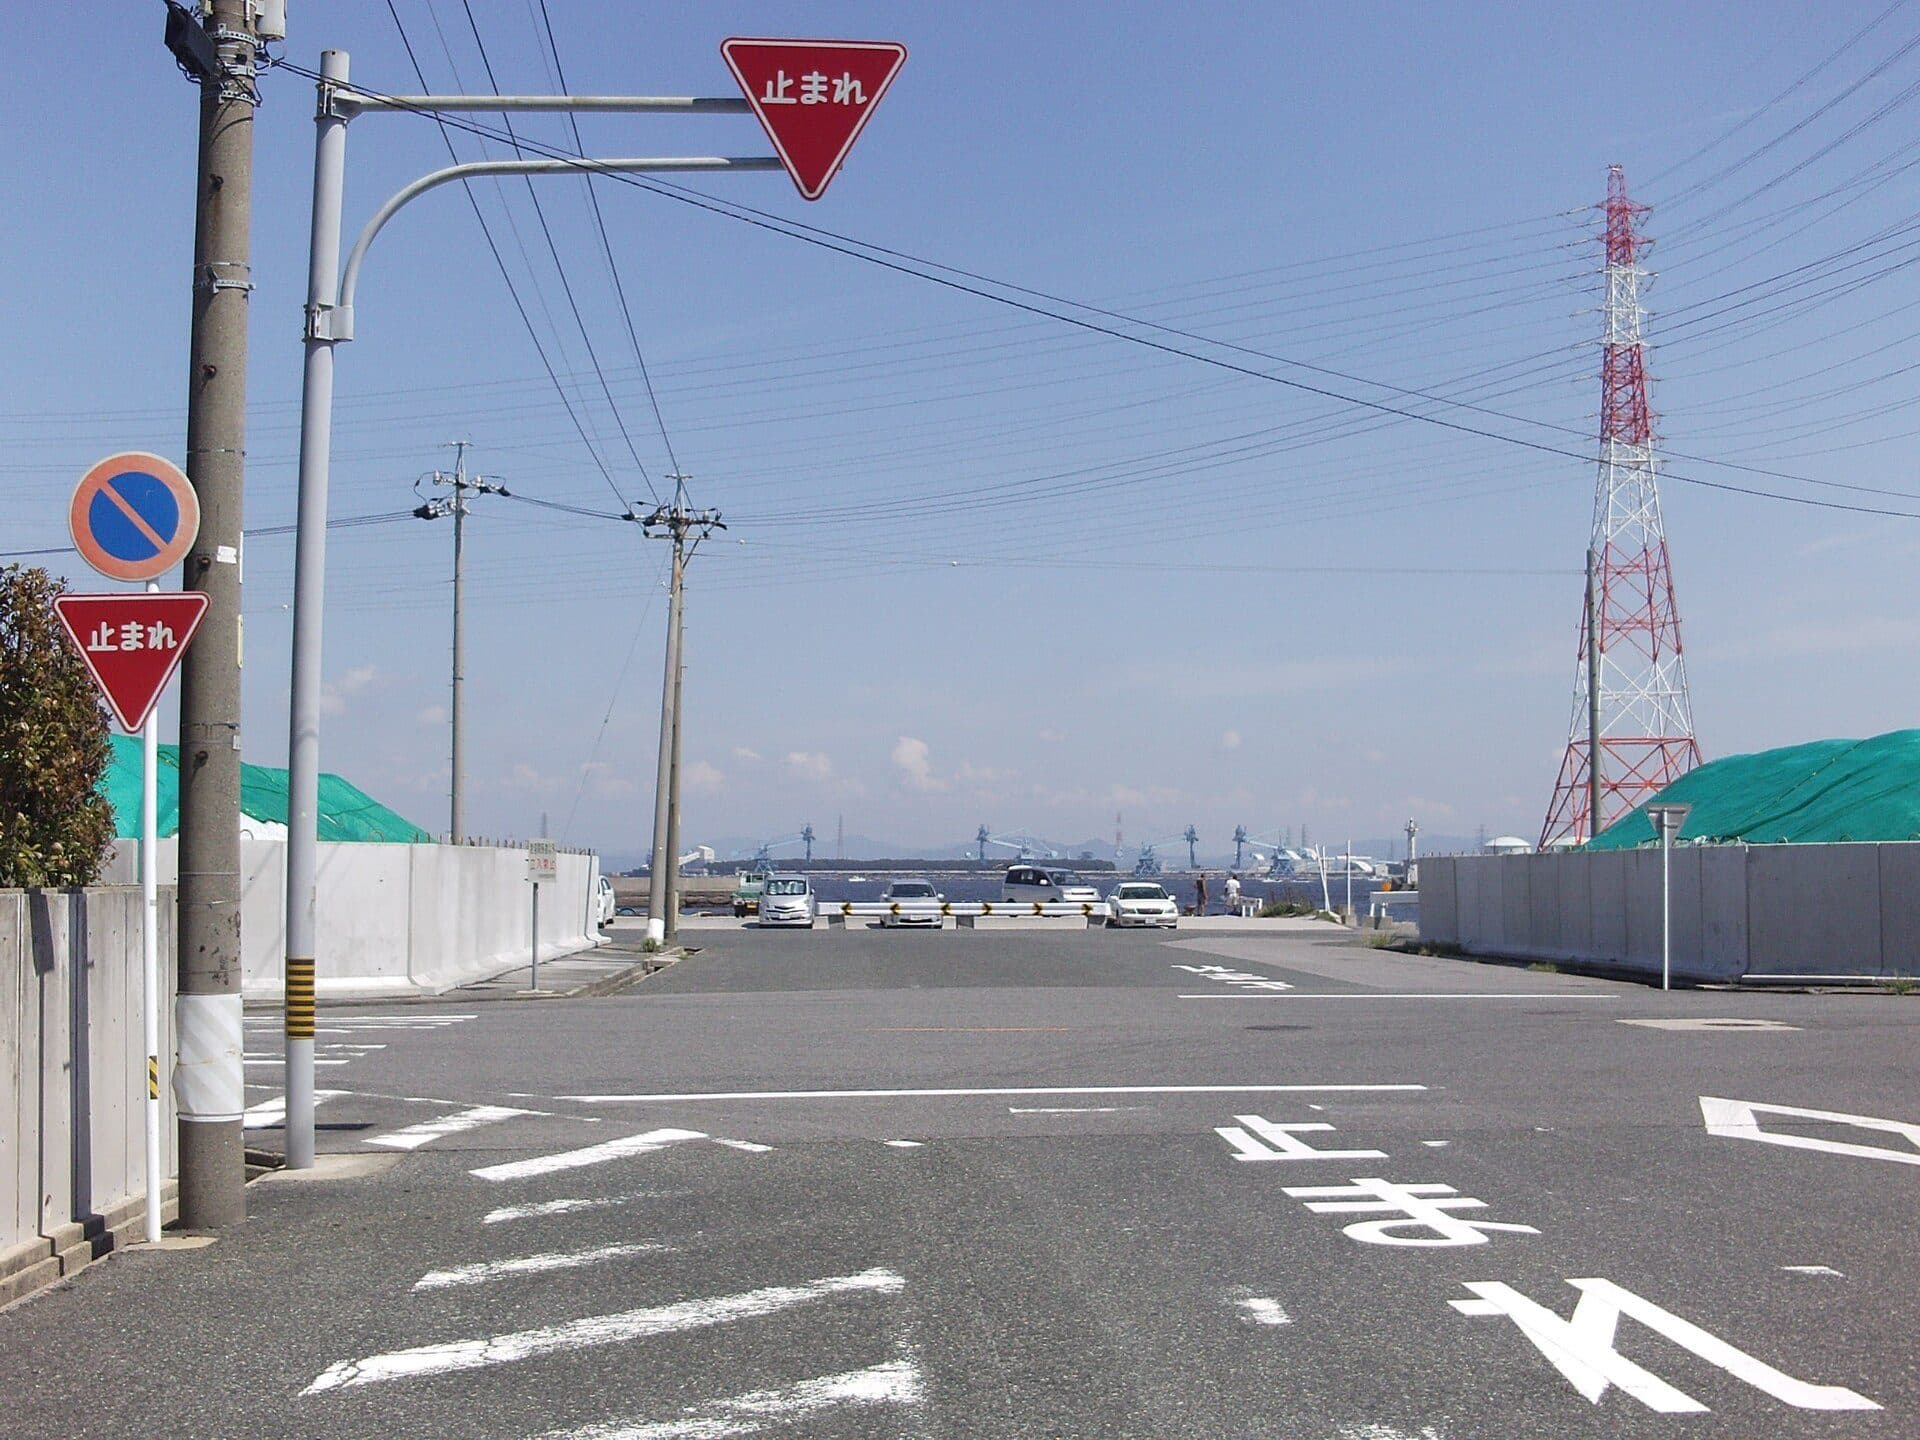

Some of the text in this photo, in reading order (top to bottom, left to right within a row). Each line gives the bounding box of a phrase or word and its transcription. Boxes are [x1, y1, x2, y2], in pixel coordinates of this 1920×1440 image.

[760, 70, 867, 105] 止まれ
[87, 621, 177, 651] 止まれ
